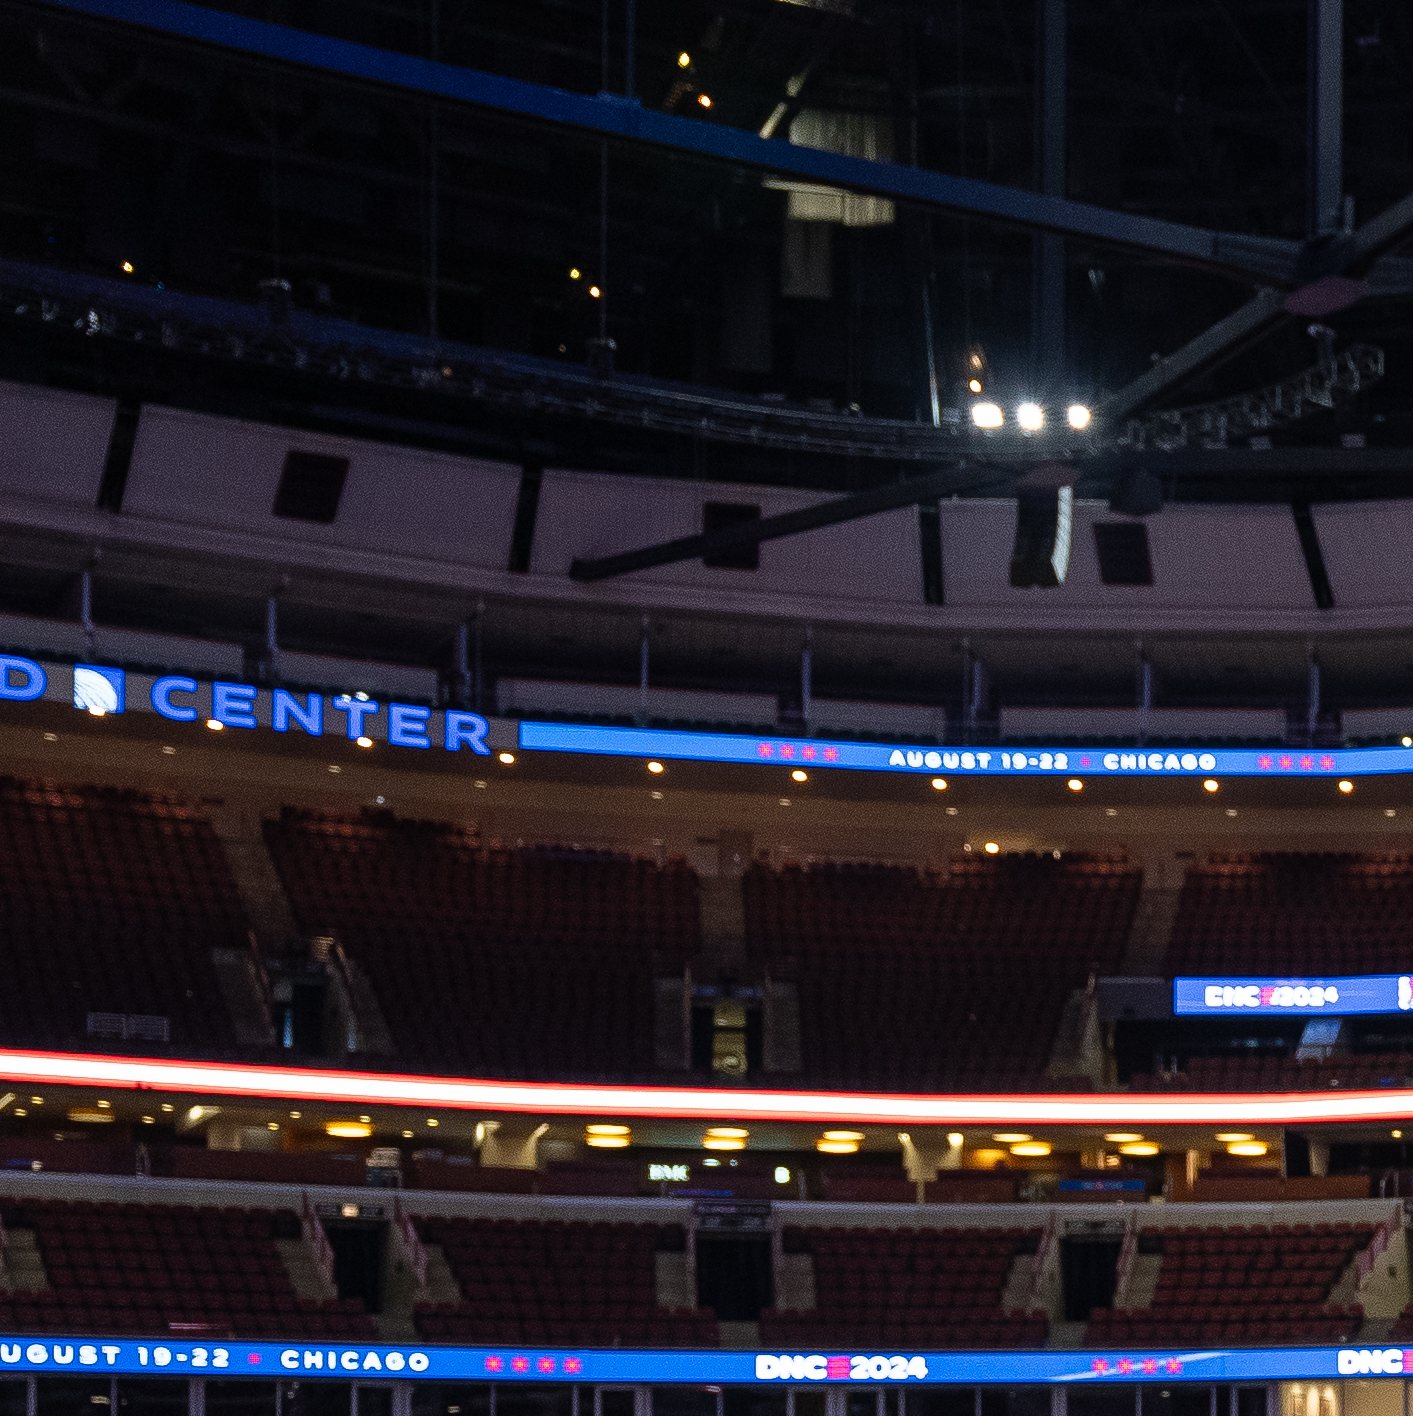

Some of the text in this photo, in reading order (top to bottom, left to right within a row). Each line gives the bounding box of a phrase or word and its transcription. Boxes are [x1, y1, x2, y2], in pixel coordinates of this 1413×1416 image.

[151, 675, 491, 756] CENTER
[889, 749, 1217, 771] AUGUST 19-22 CHICAGO
[137, 1346, 230, 1368] 19-22
[280, 1349, 430, 1372] CHICAGO
[755, 1354, 930, 1380] DNC 2024
[1337, 1348, 1403, 1375] DNC
